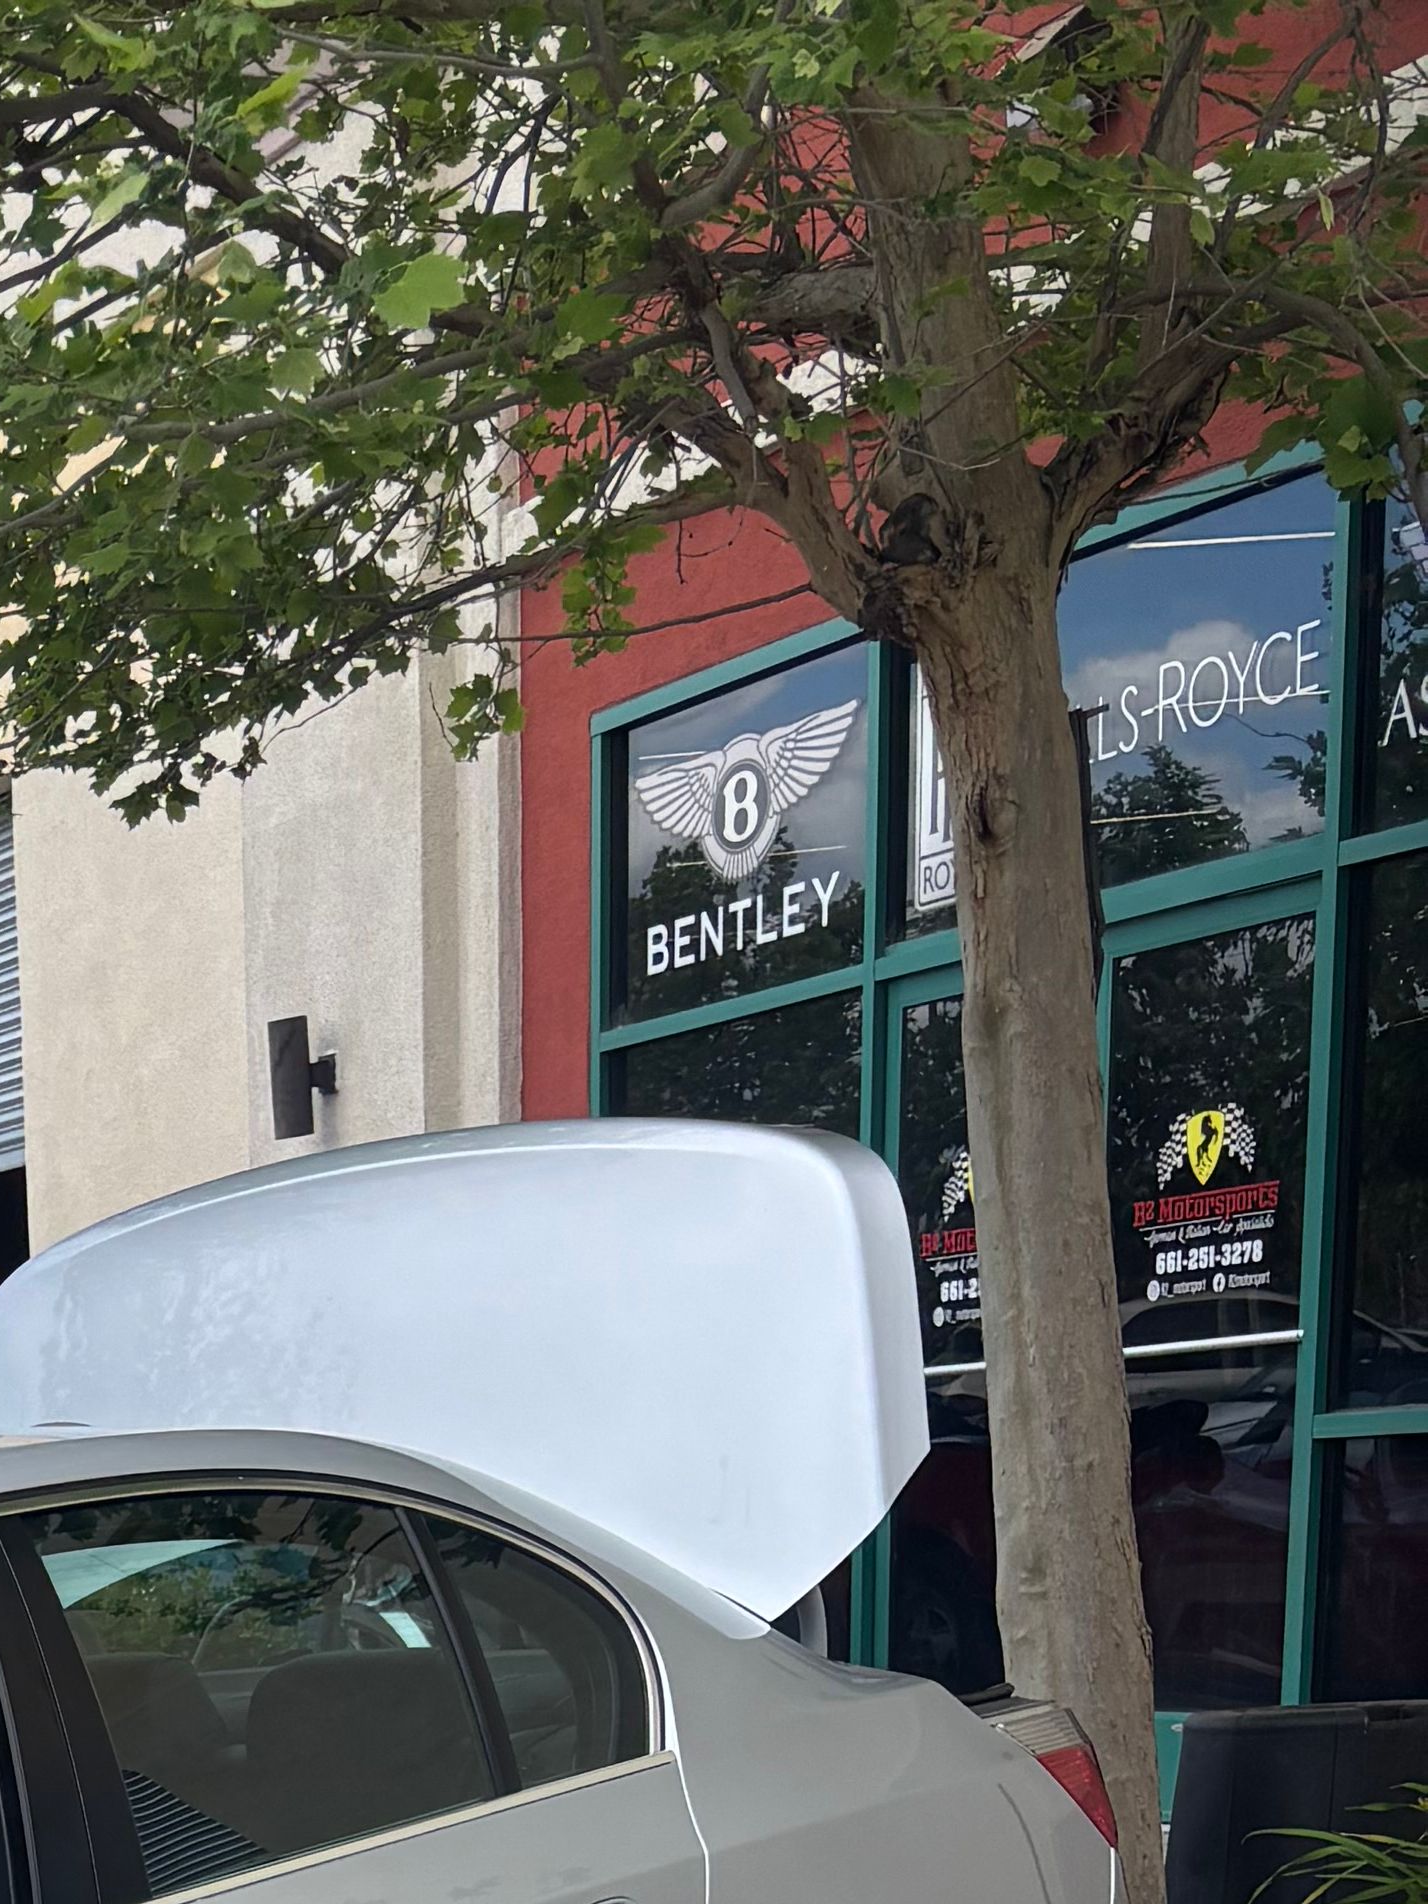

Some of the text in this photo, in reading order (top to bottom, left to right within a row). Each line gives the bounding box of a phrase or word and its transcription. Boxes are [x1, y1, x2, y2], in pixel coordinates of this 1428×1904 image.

[646, 870, 841, 977] BENTLEY
[1157, 1184, 1280, 1224] Motorsports
[1155, 1239, 1264, 1275] 661-251-3278
